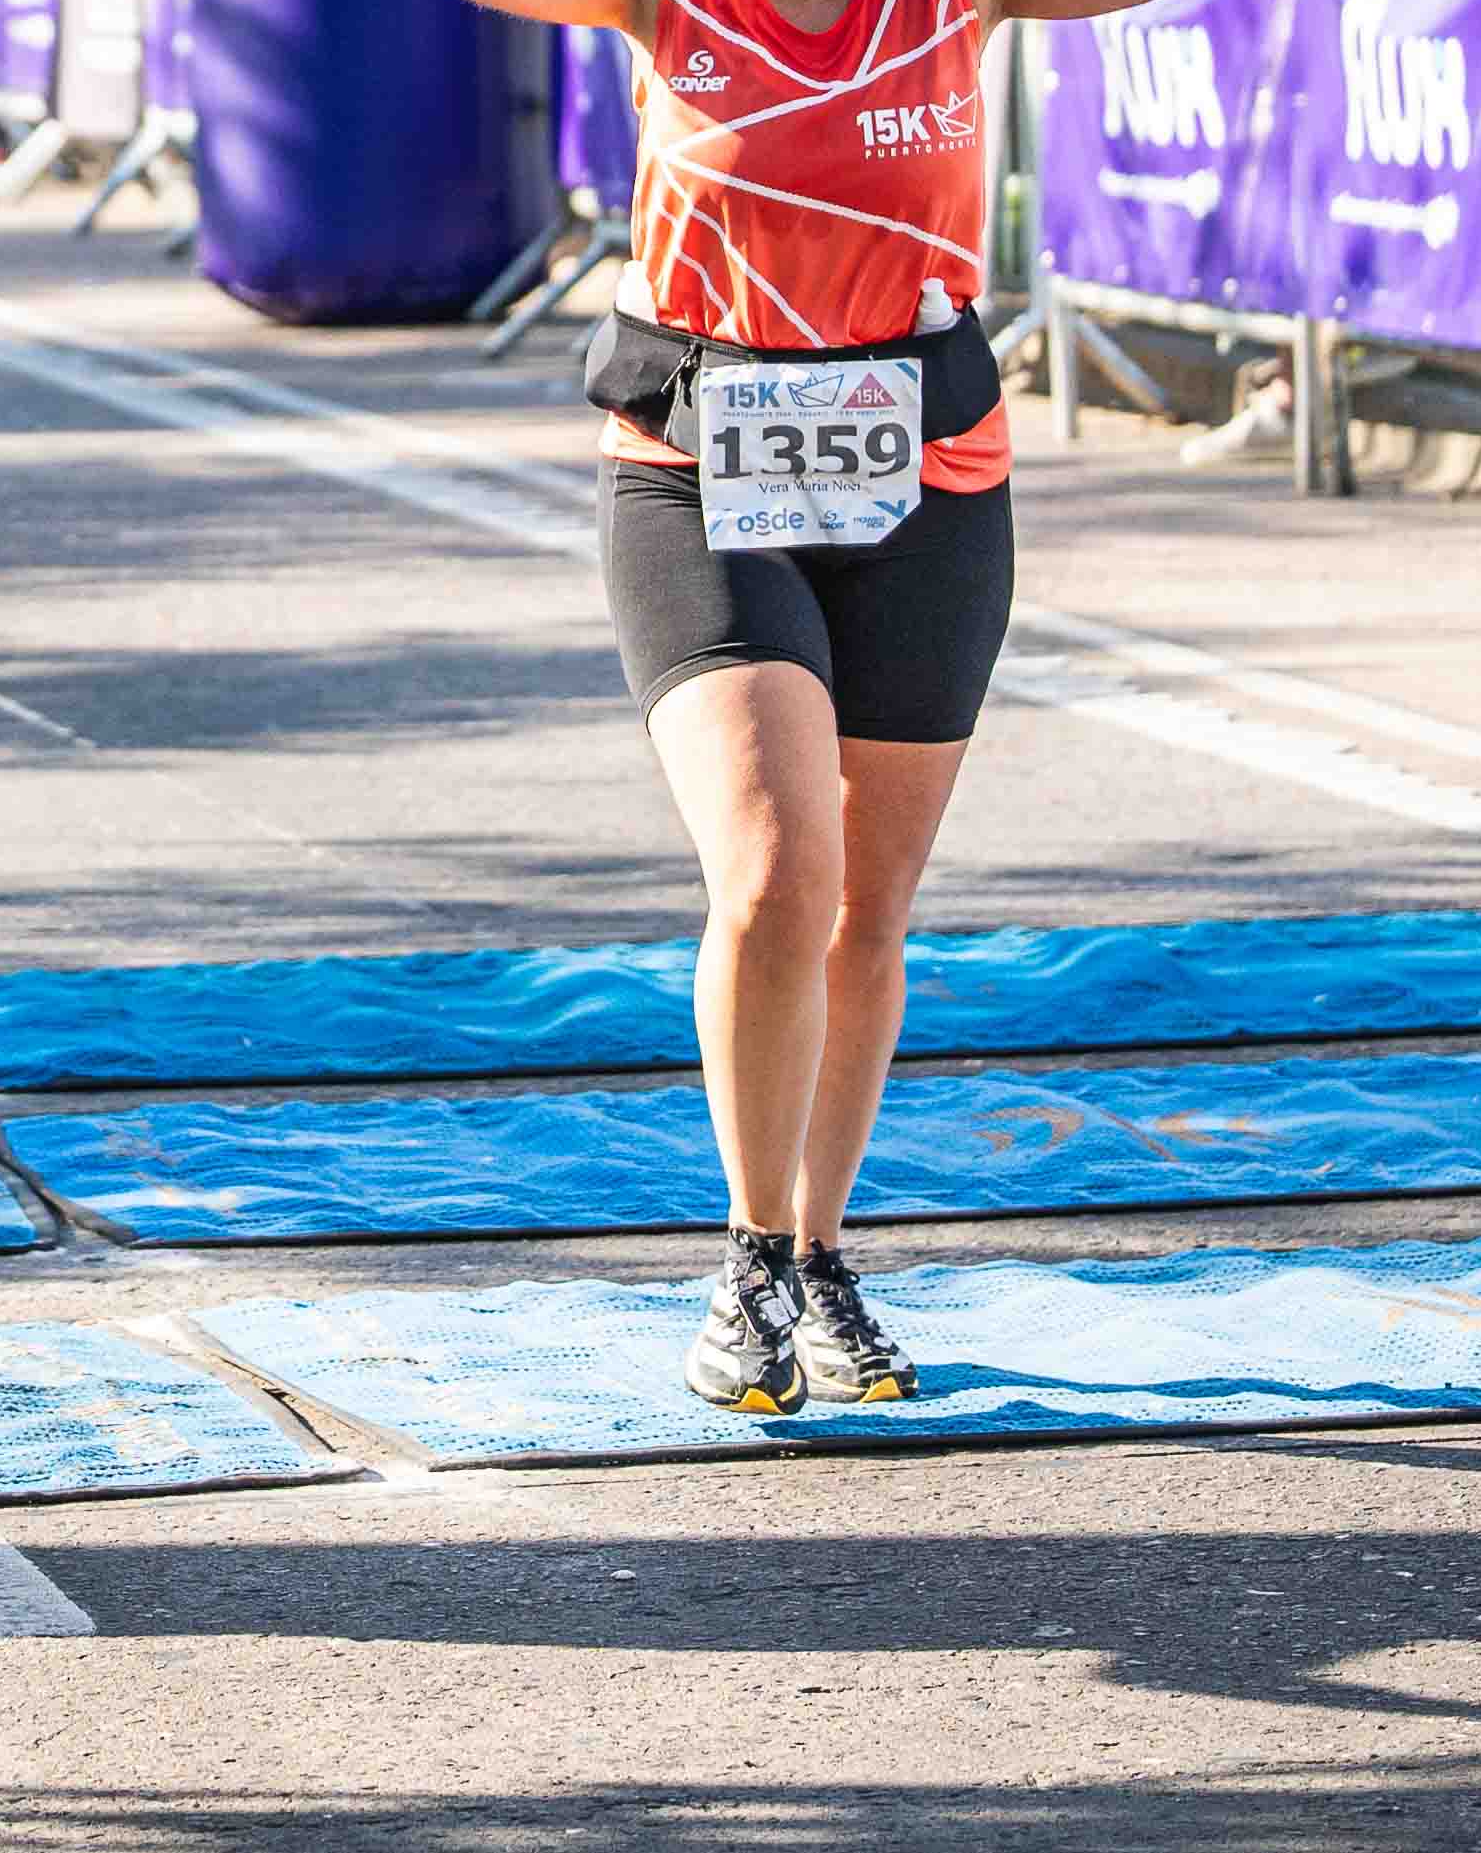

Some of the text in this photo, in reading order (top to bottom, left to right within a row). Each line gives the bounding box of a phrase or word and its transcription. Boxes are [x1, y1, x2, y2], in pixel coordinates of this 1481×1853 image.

[856, 105, 931, 147] 15K
[865, 144, 932, 160] PUERTO
[722, 380, 781, 409] 15K
[855, 387, 886, 405] 15K
[711, 421, 911, 480] 1359
[757, 481, 789, 494] Vera
[794, 479, 828, 493] Maria
[737, 508, 805, 533] osde
